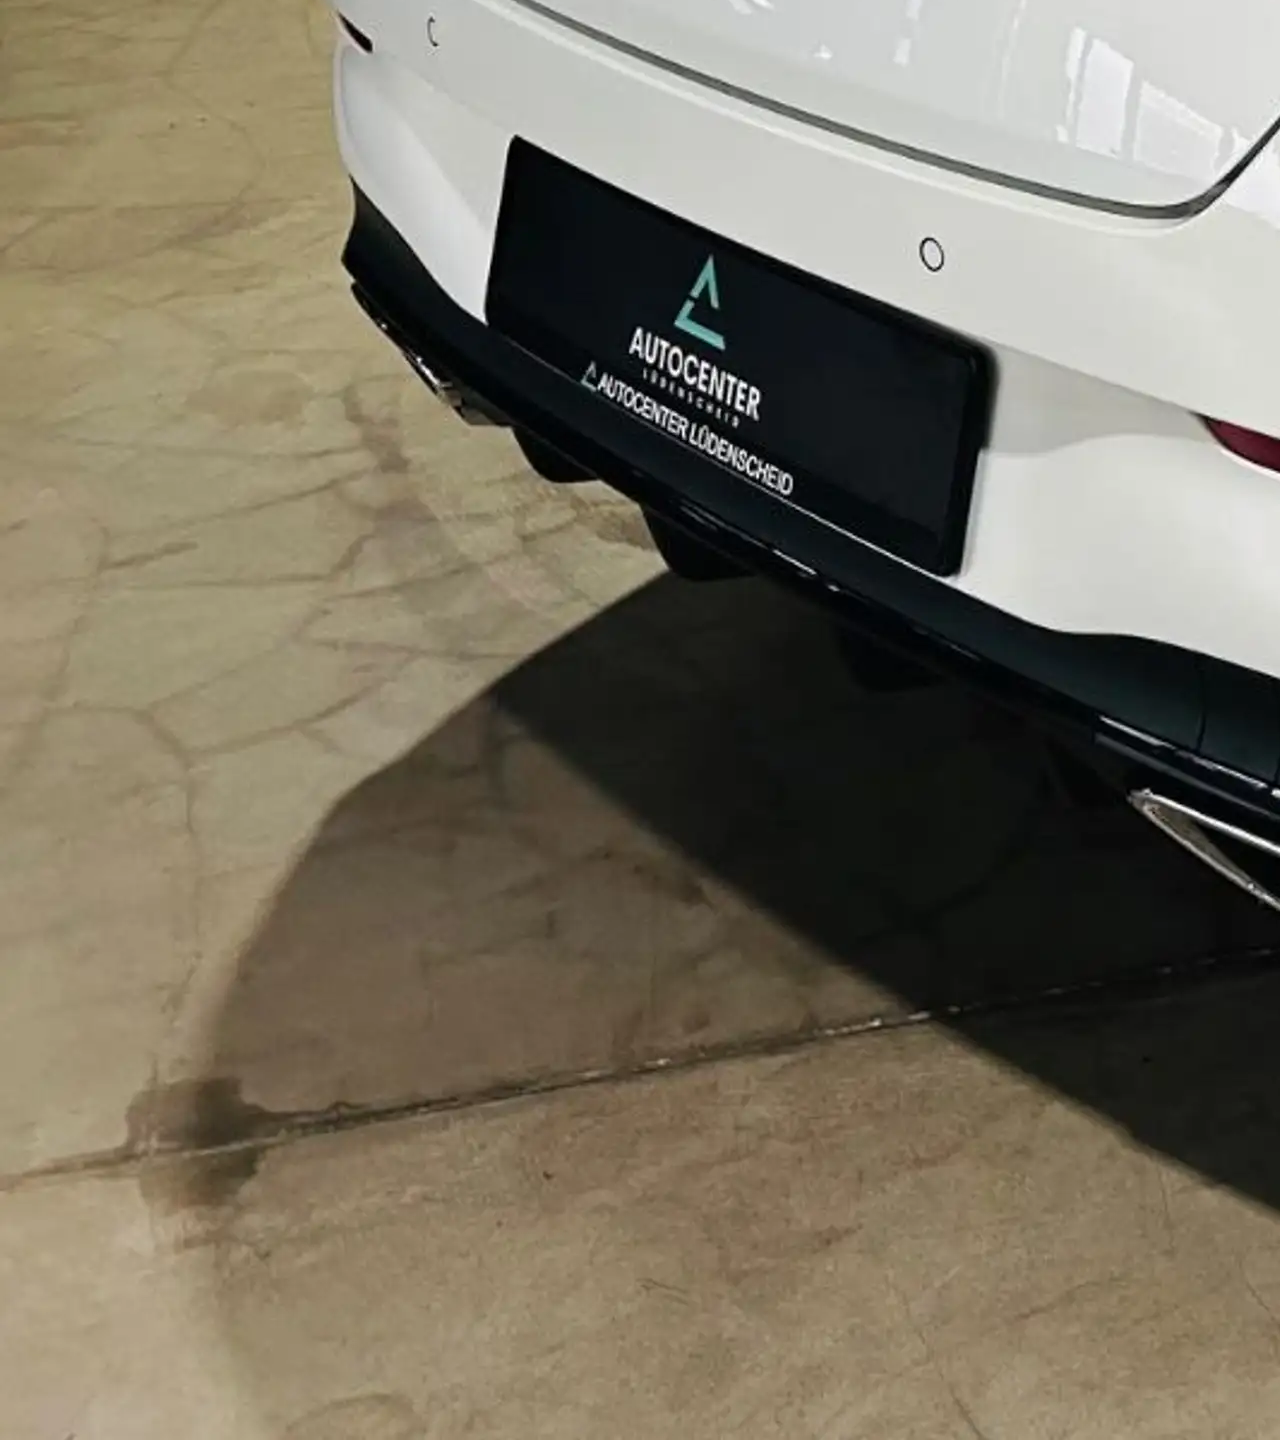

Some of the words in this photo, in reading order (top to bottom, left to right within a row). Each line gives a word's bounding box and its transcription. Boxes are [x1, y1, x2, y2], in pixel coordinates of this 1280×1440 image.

[628, 326, 762, 421] AUTOCENTER
[598, 371, 690, 441] AUTOCENTER
[688, 422, 794, 496] LÜDENSCHEID
